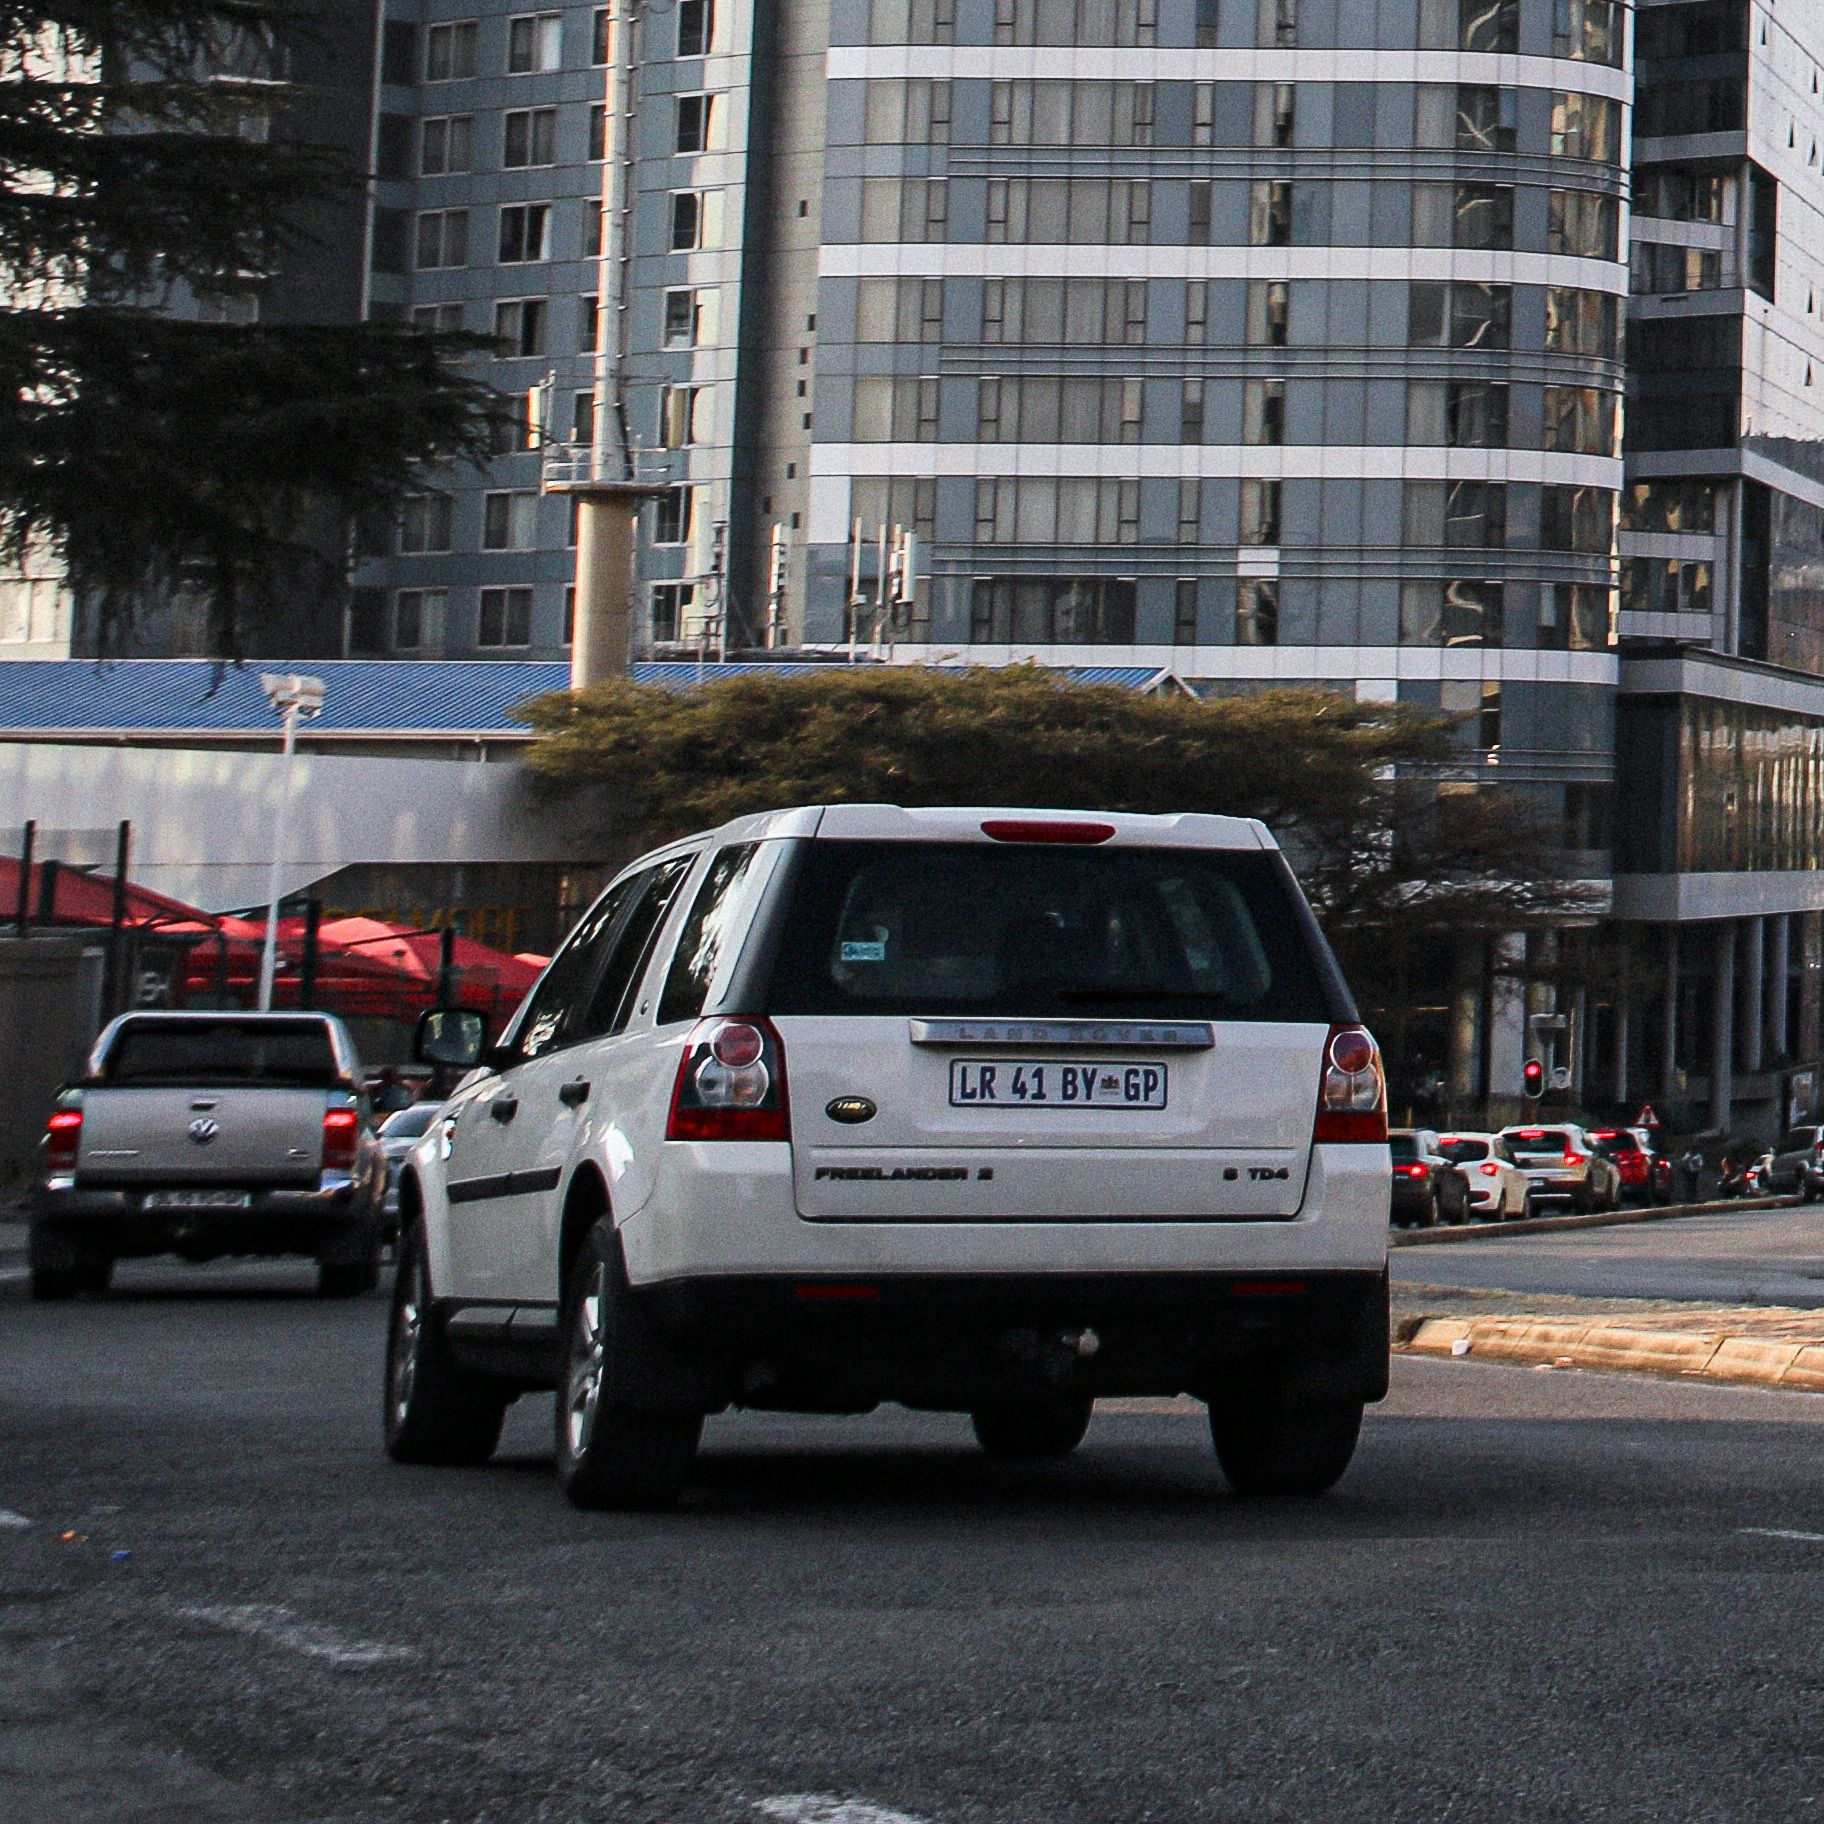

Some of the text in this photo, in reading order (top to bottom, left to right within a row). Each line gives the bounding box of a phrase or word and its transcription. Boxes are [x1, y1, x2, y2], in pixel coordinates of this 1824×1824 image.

[960, 1066, 1159, 1102] LR 41 BY GP
[814, 1166, 969, 1181] FREELANDER
[1247, 1167, 1290, 1181] TD4
